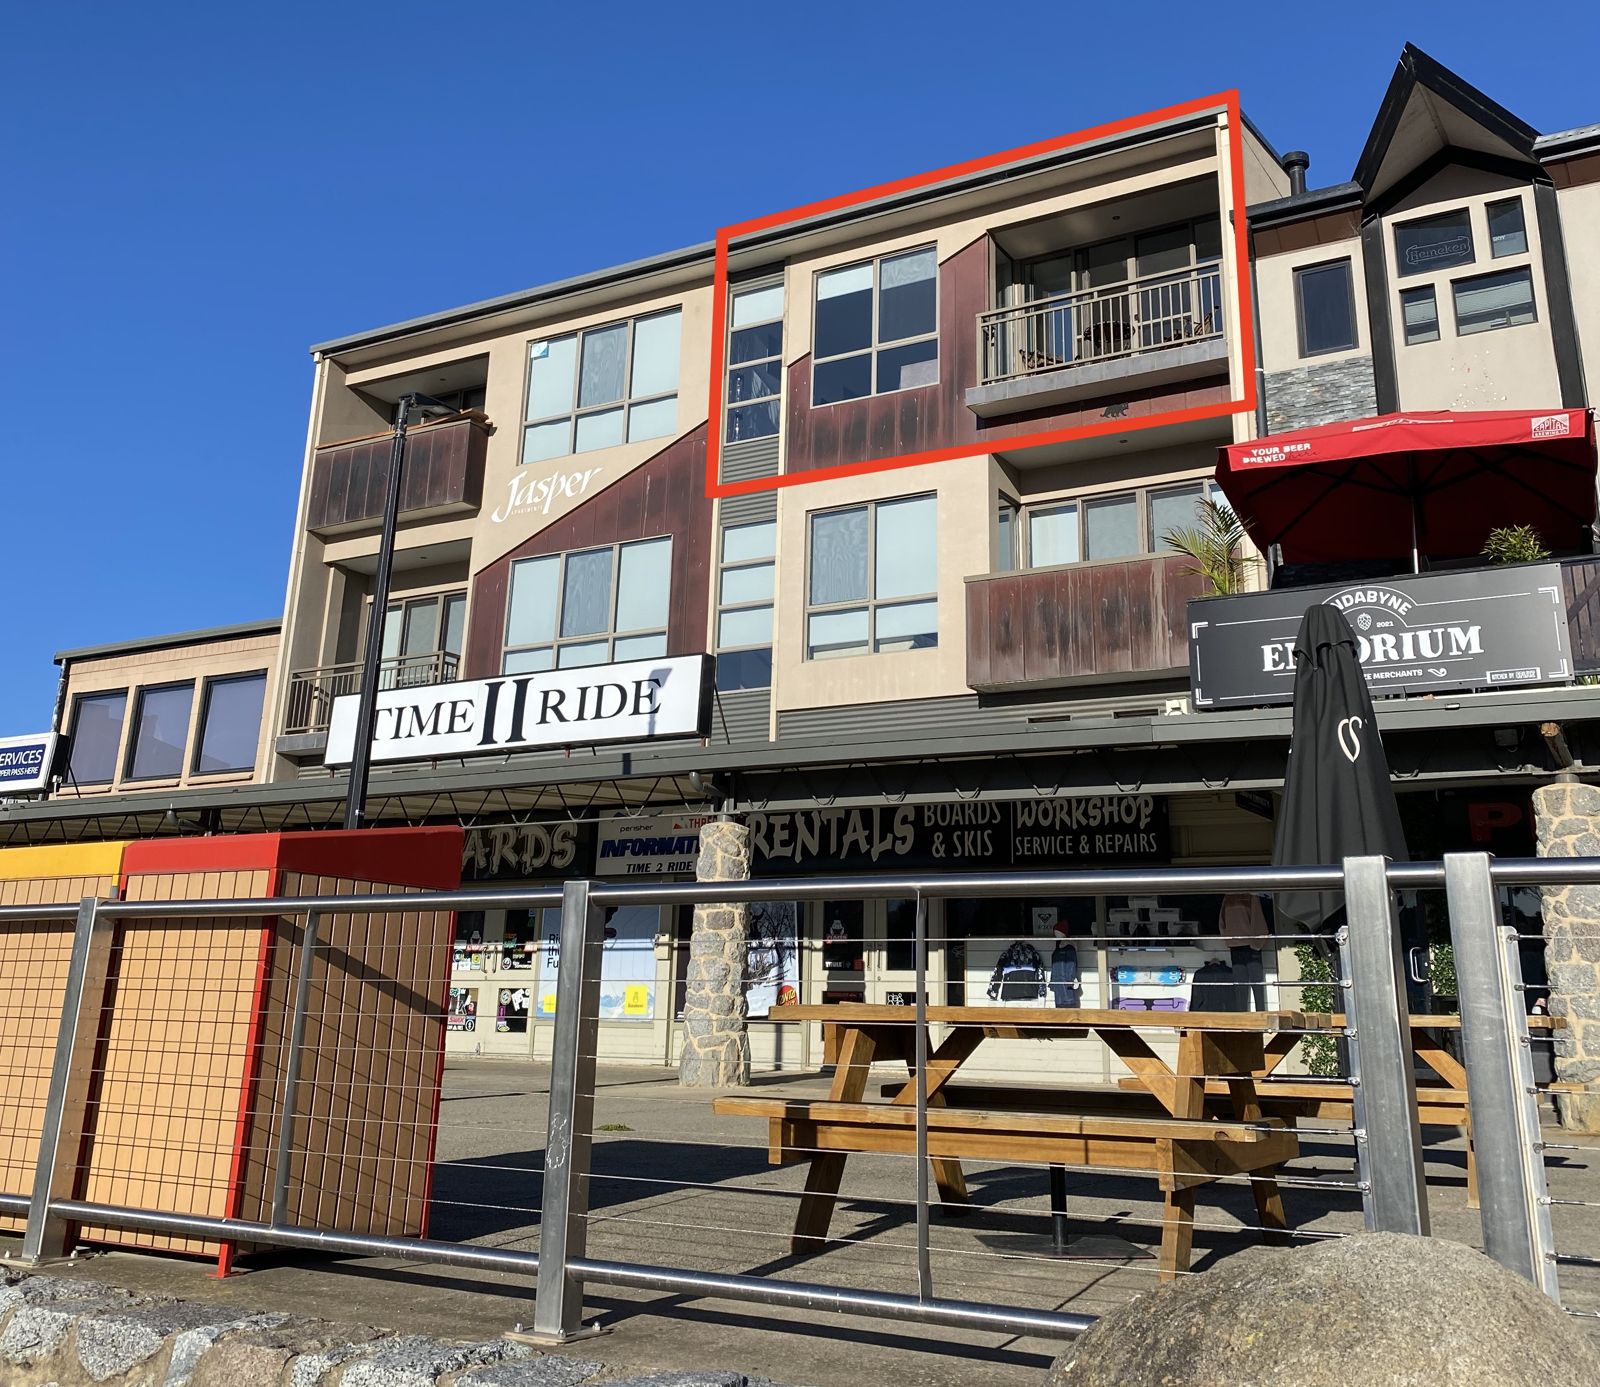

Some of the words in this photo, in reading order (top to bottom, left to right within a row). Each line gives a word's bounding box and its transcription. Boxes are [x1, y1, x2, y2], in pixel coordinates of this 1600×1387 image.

[1410, 242, 1467, 261] Heineken
[1535, 417, 1567, 431] CAPITAL
[1242, 453, 1286, 464] BREWED
[1251, 446, 1280, 457] YOUR
[1283, 443, 1311, 453] BEER
[491, 467, 604, 523] Jasper
[1376, 621, 1395, 629] 2021
[1261, 625, 1485, 672] ERIUM
[1373, 669, 1424, 680] MERCHANTS
[373, 699, 475, 741] TIME
[536, 678, 662, 725] RIDE
[924, 801, 1001, 827] BOARDS
[1016, 795, 1154, 831] WORKSHOP
[620, 824, 654, 833] perisher
[745, 804, 915, 867] RENTALS
[932, 832, 946, 858] &
[953, 830, 993, 857] SKIS
[1015, 836, 1074, 856] SERVICE
[1079, 835, 1090, 854] &
[1095, 833, 1157, 854] REPAIRS
[626, 863, 652, 874] TIME
[655, 863, 663, 872] 2
[667, 861, 693, 872] RIDE
